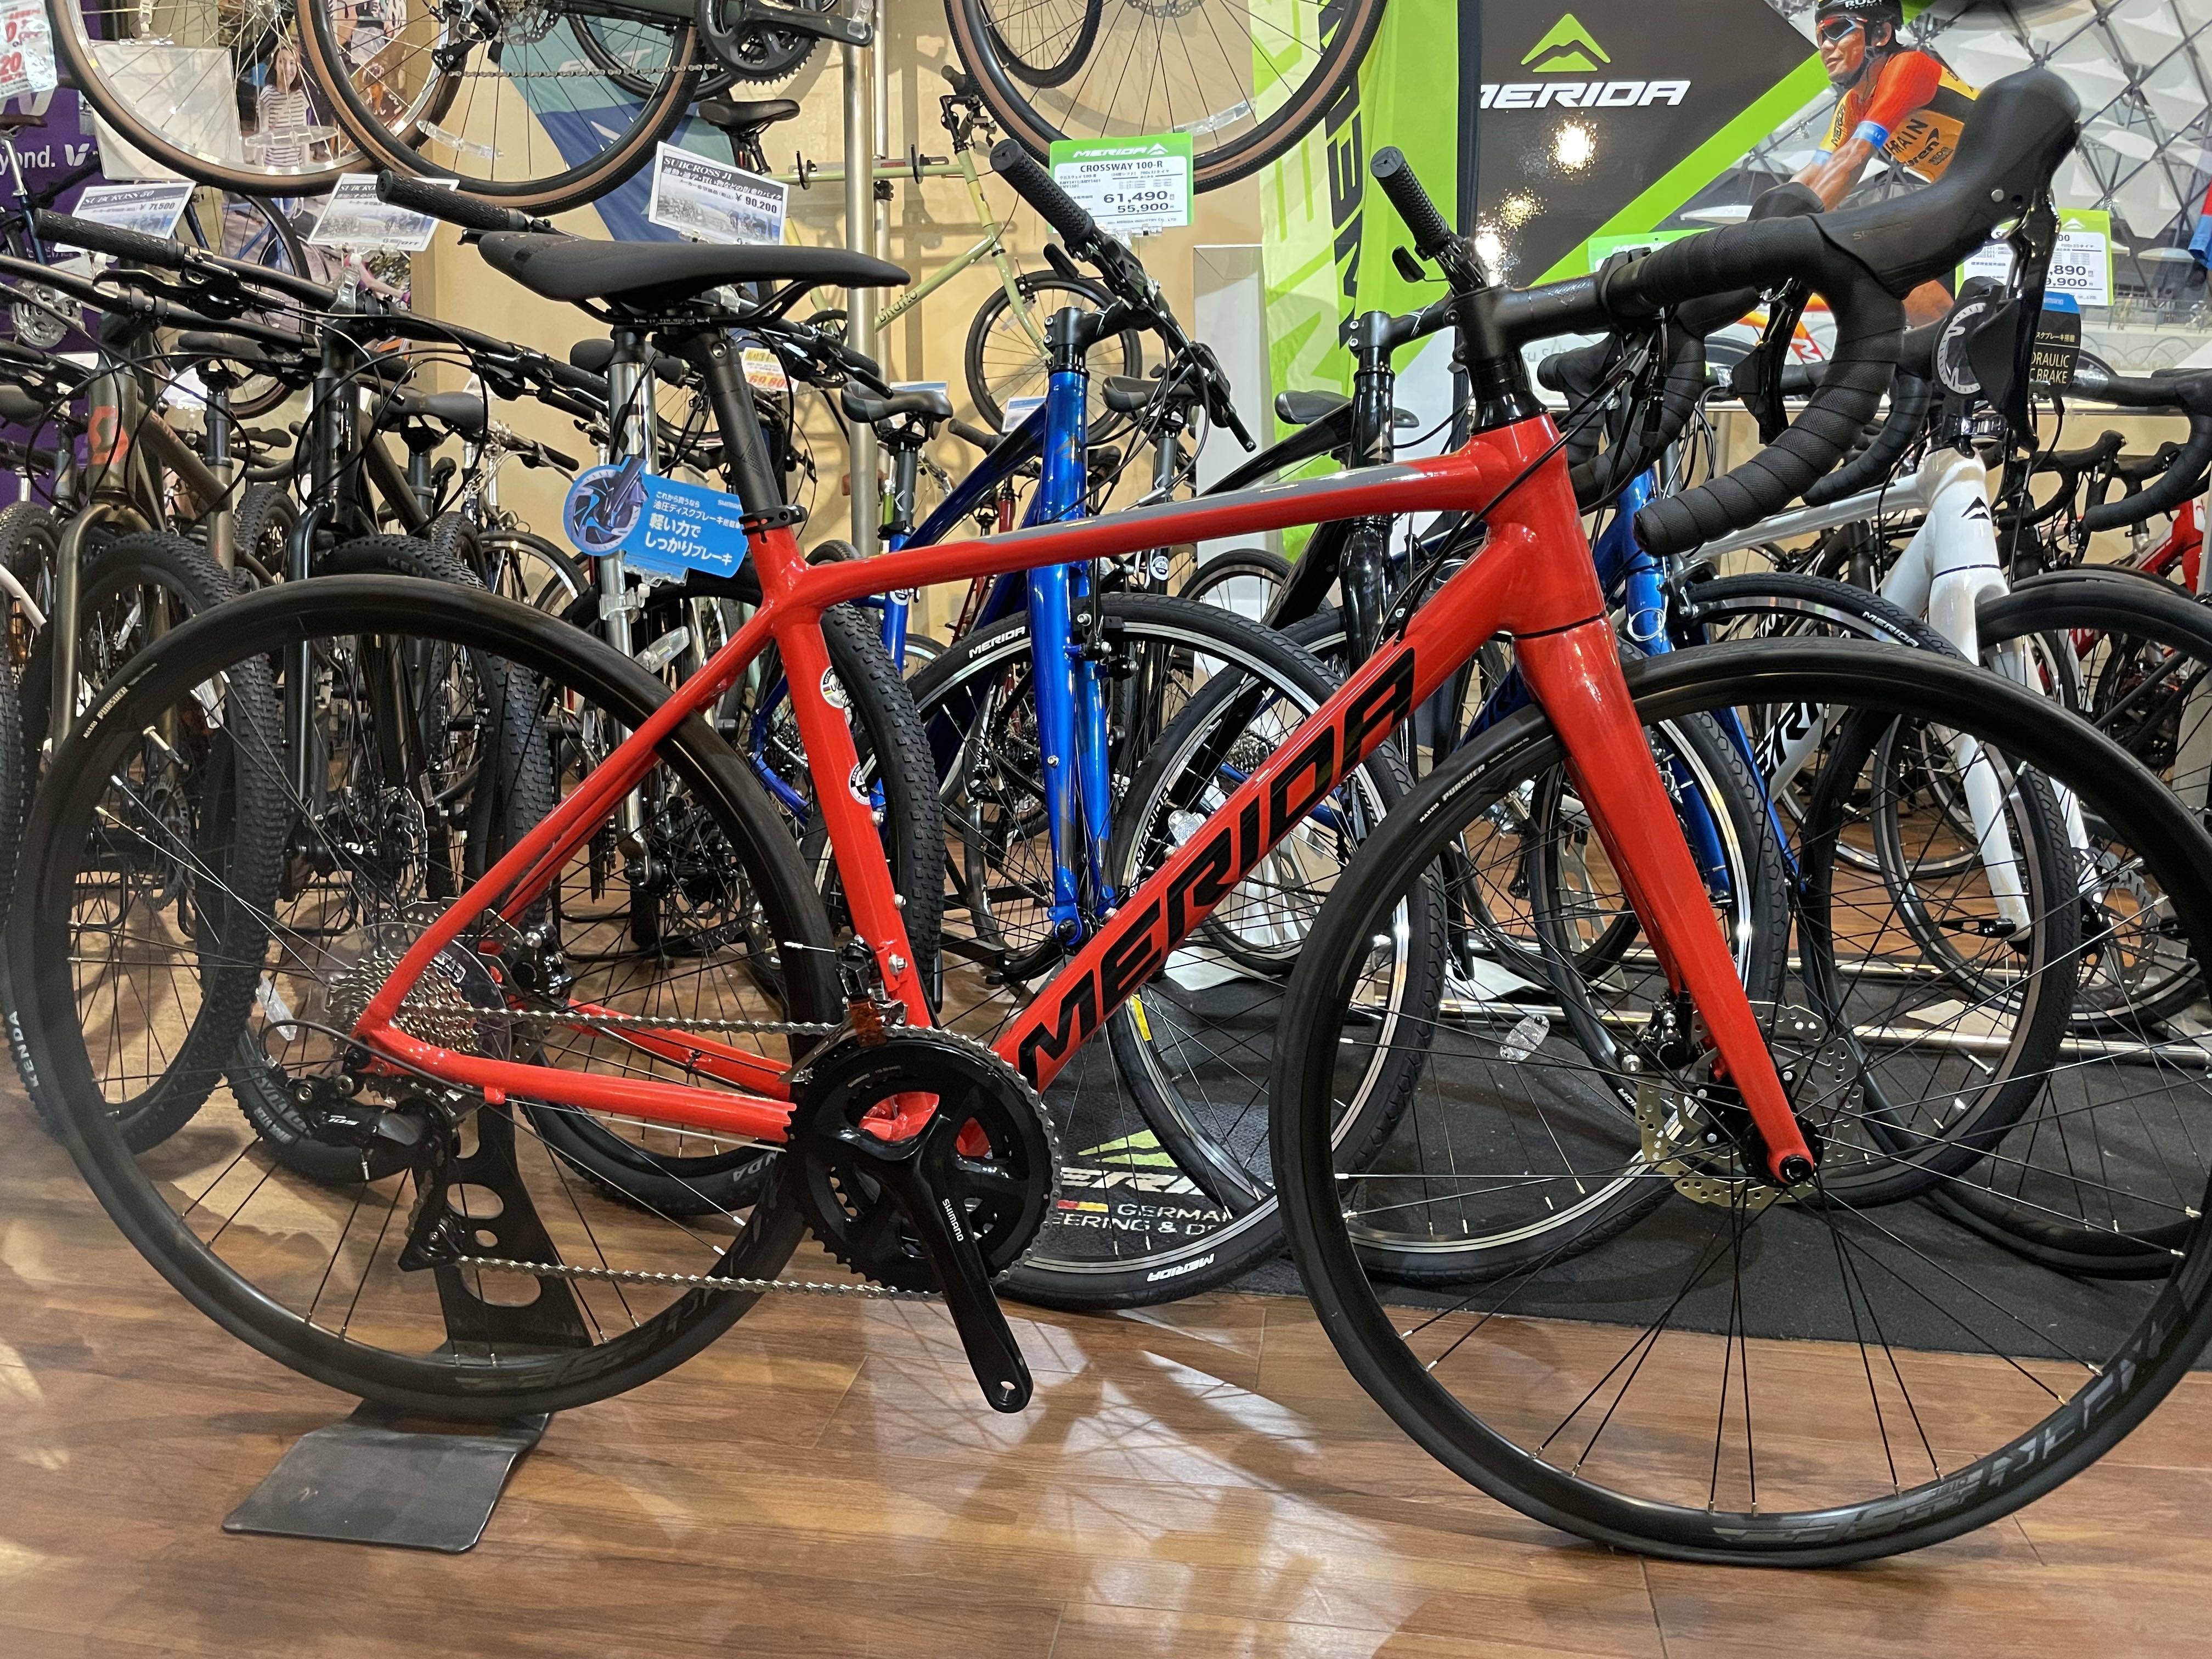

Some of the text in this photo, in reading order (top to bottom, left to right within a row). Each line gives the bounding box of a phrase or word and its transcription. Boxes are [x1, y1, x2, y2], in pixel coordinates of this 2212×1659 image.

[1073, 146, 1148, 158] MERIDA
[663, 157, 720, 179] SUBCROSS
[1080, 160, 1163, 173] CROSSWAY 100-R
[1103, 190, 1168, 204] 61,490
[1117, 202, 1169, 213] 55,900
[2036, 368, 2068, 384] BRAKE
[649, 512, 701, 538] 軽い力で
[645, 532, 733, 566] しっかりブレーキ
[968, 625, 1026, 659] MERIDA
[1862, 611, 1920, 648] MERIDA
[1441, 764, 1486, 801] PURSUER
[1018, 647, 1415, 1089] MERIDA
[8, 1011, 40, 1087] KENDA
[942, 1198, 964, 1242] SHIMANO
[1158, 1221, 1177, 1233] &
[1147, 1253, 1215, 1282] MERIDA
